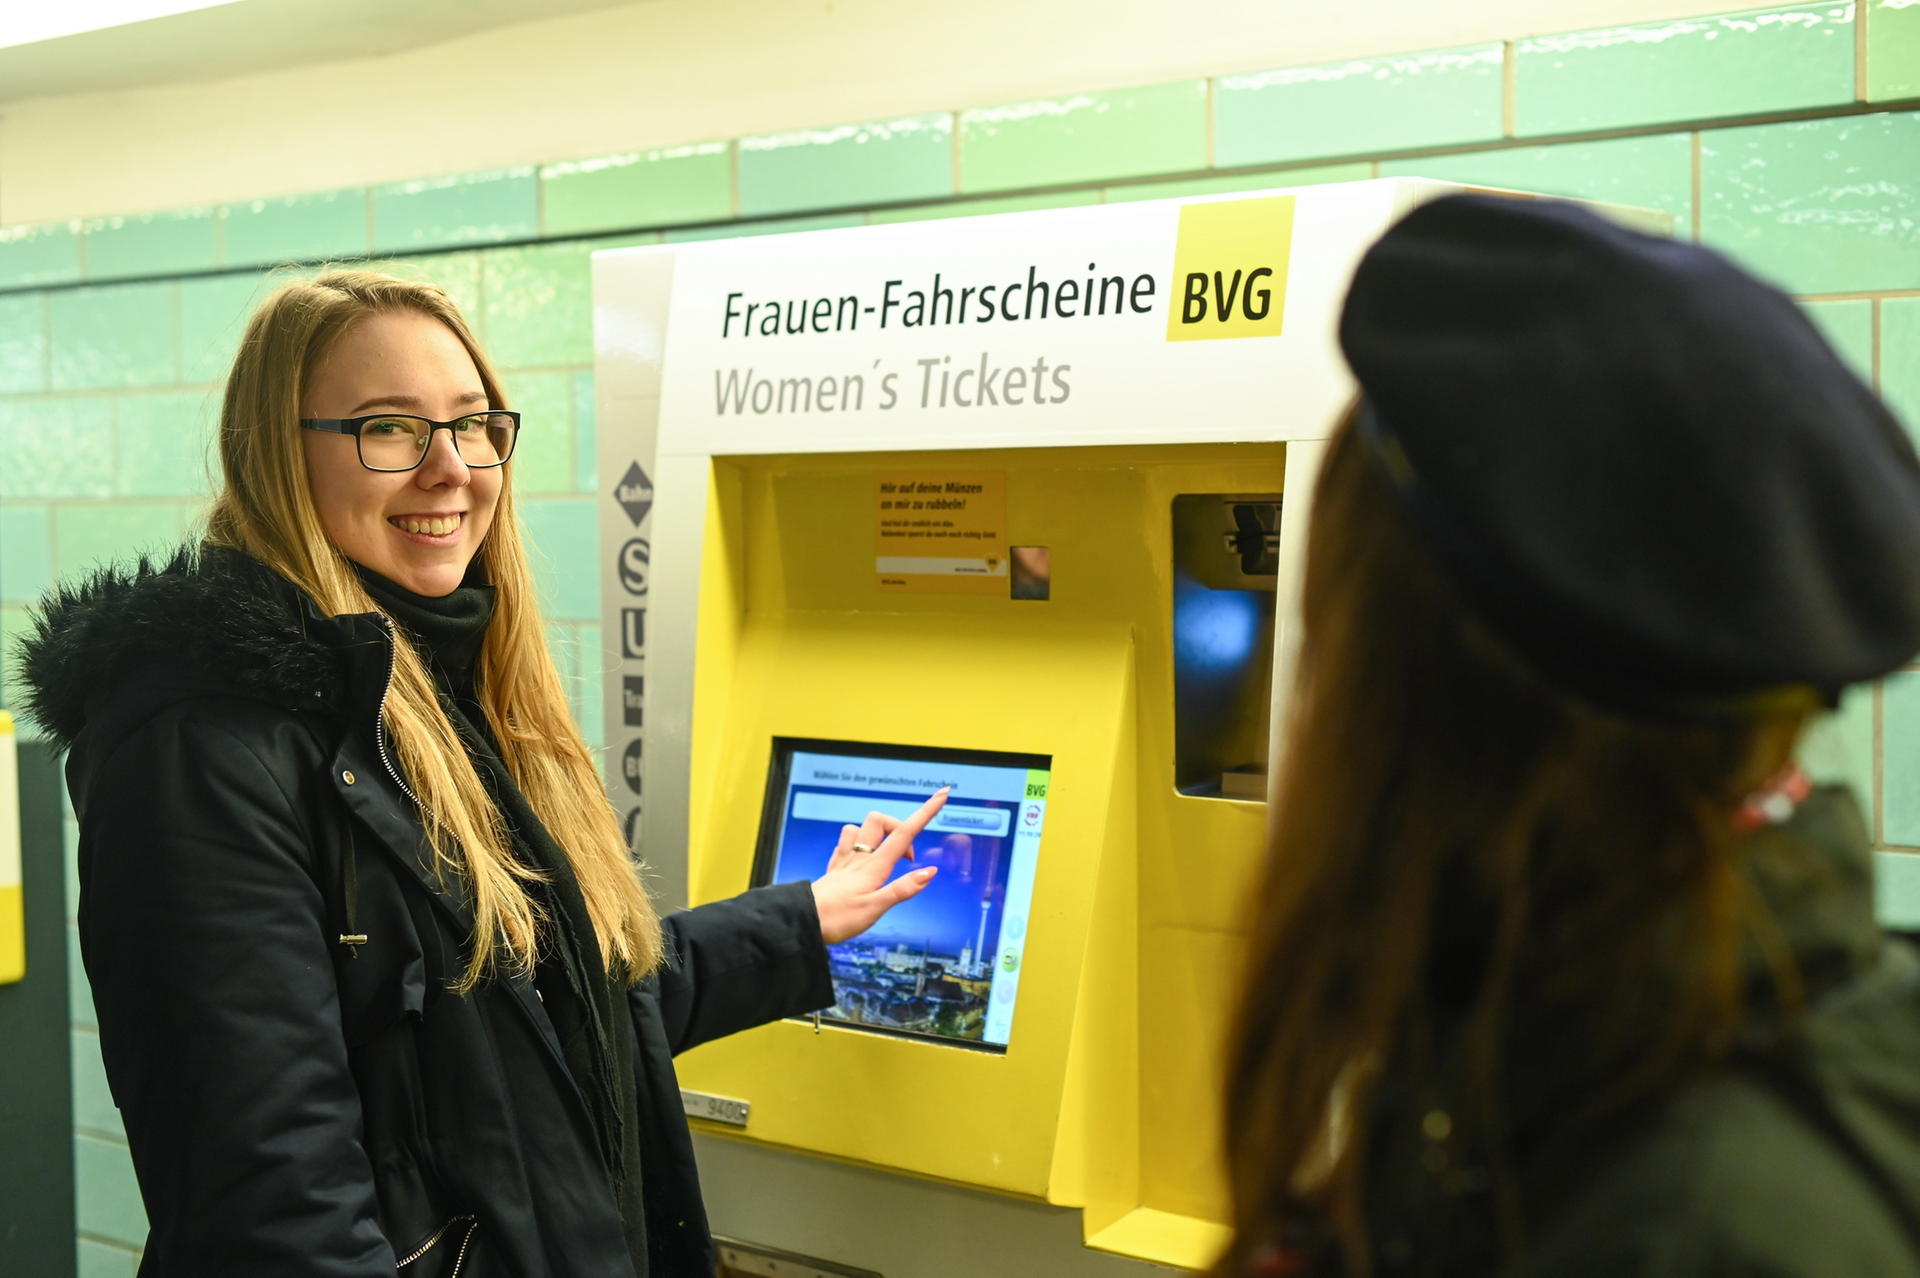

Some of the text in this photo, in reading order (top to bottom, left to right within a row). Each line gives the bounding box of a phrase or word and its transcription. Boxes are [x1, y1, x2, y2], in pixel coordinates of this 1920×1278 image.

[722, 262, 1156, 338] Frauen-Fahrscheine
[1181, 267, 1274, 324] BVG
[916, 352, 1071, 409] Tickets
[917, 483, 942, 493] deine
[853, 774, 867, 782] den
[1026, 785, 1046, 797] BVG
